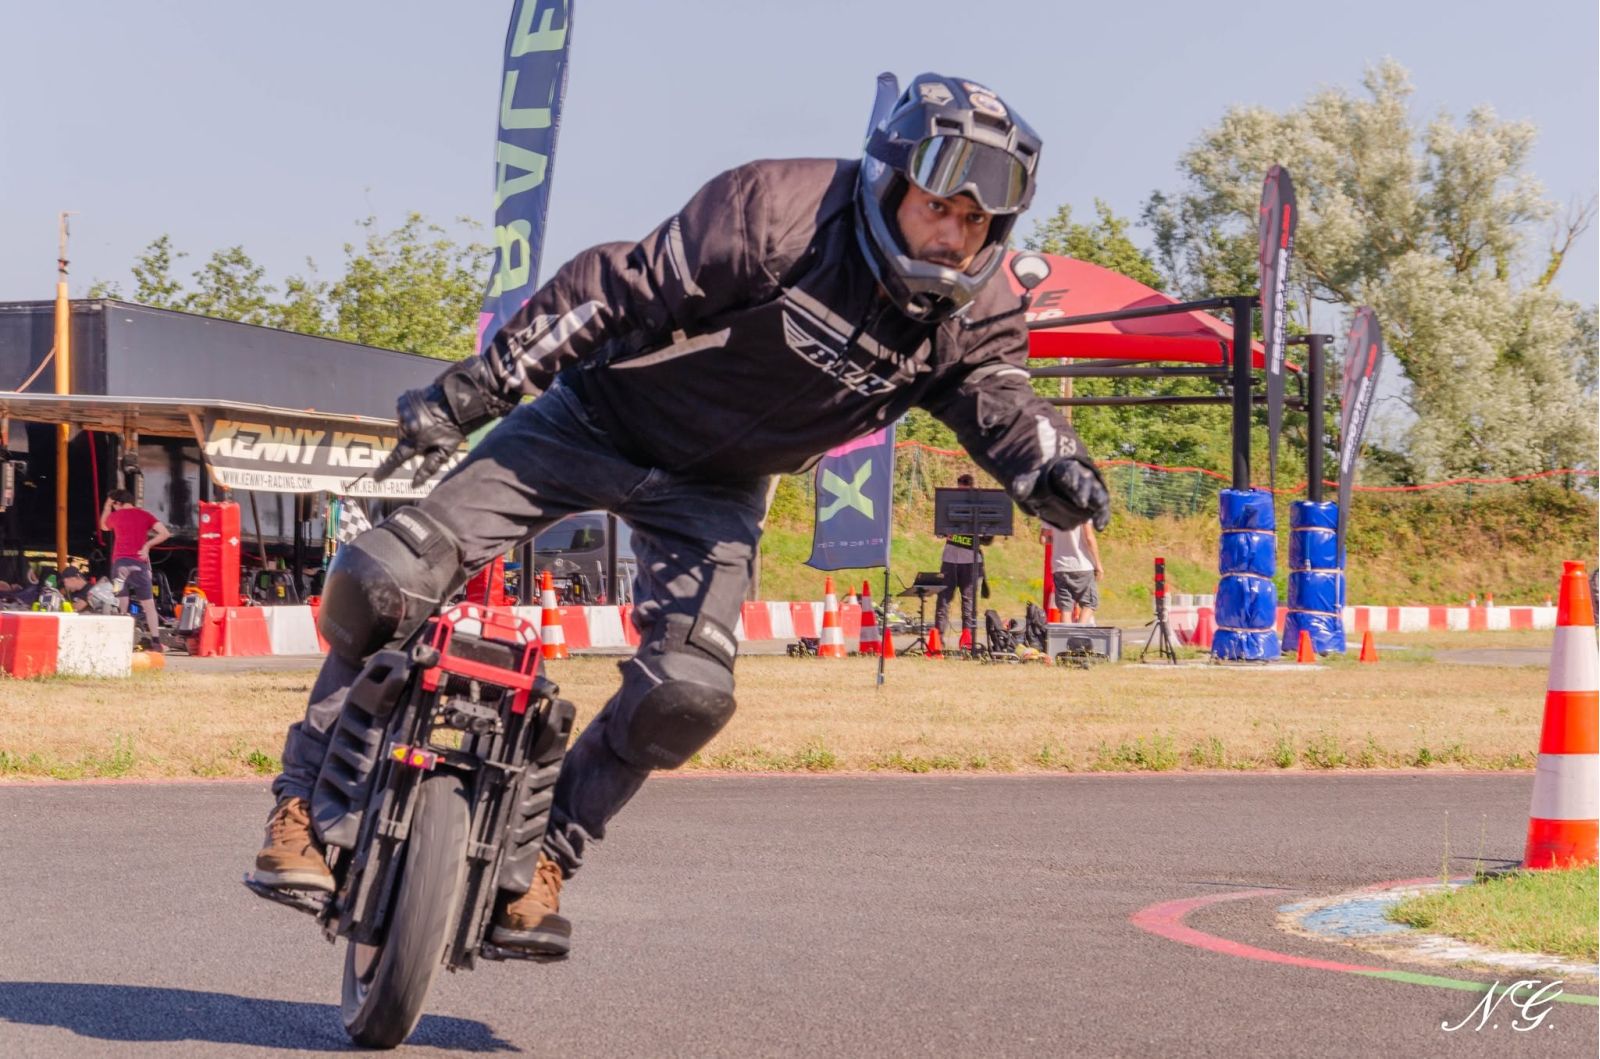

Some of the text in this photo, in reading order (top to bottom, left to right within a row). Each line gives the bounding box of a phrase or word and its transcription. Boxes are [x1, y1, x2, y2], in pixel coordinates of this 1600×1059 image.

[205, 419, 326, 465] KENNY
[327, 431, 426, 471] KEN
[952, 534, 973, 546] RACE
